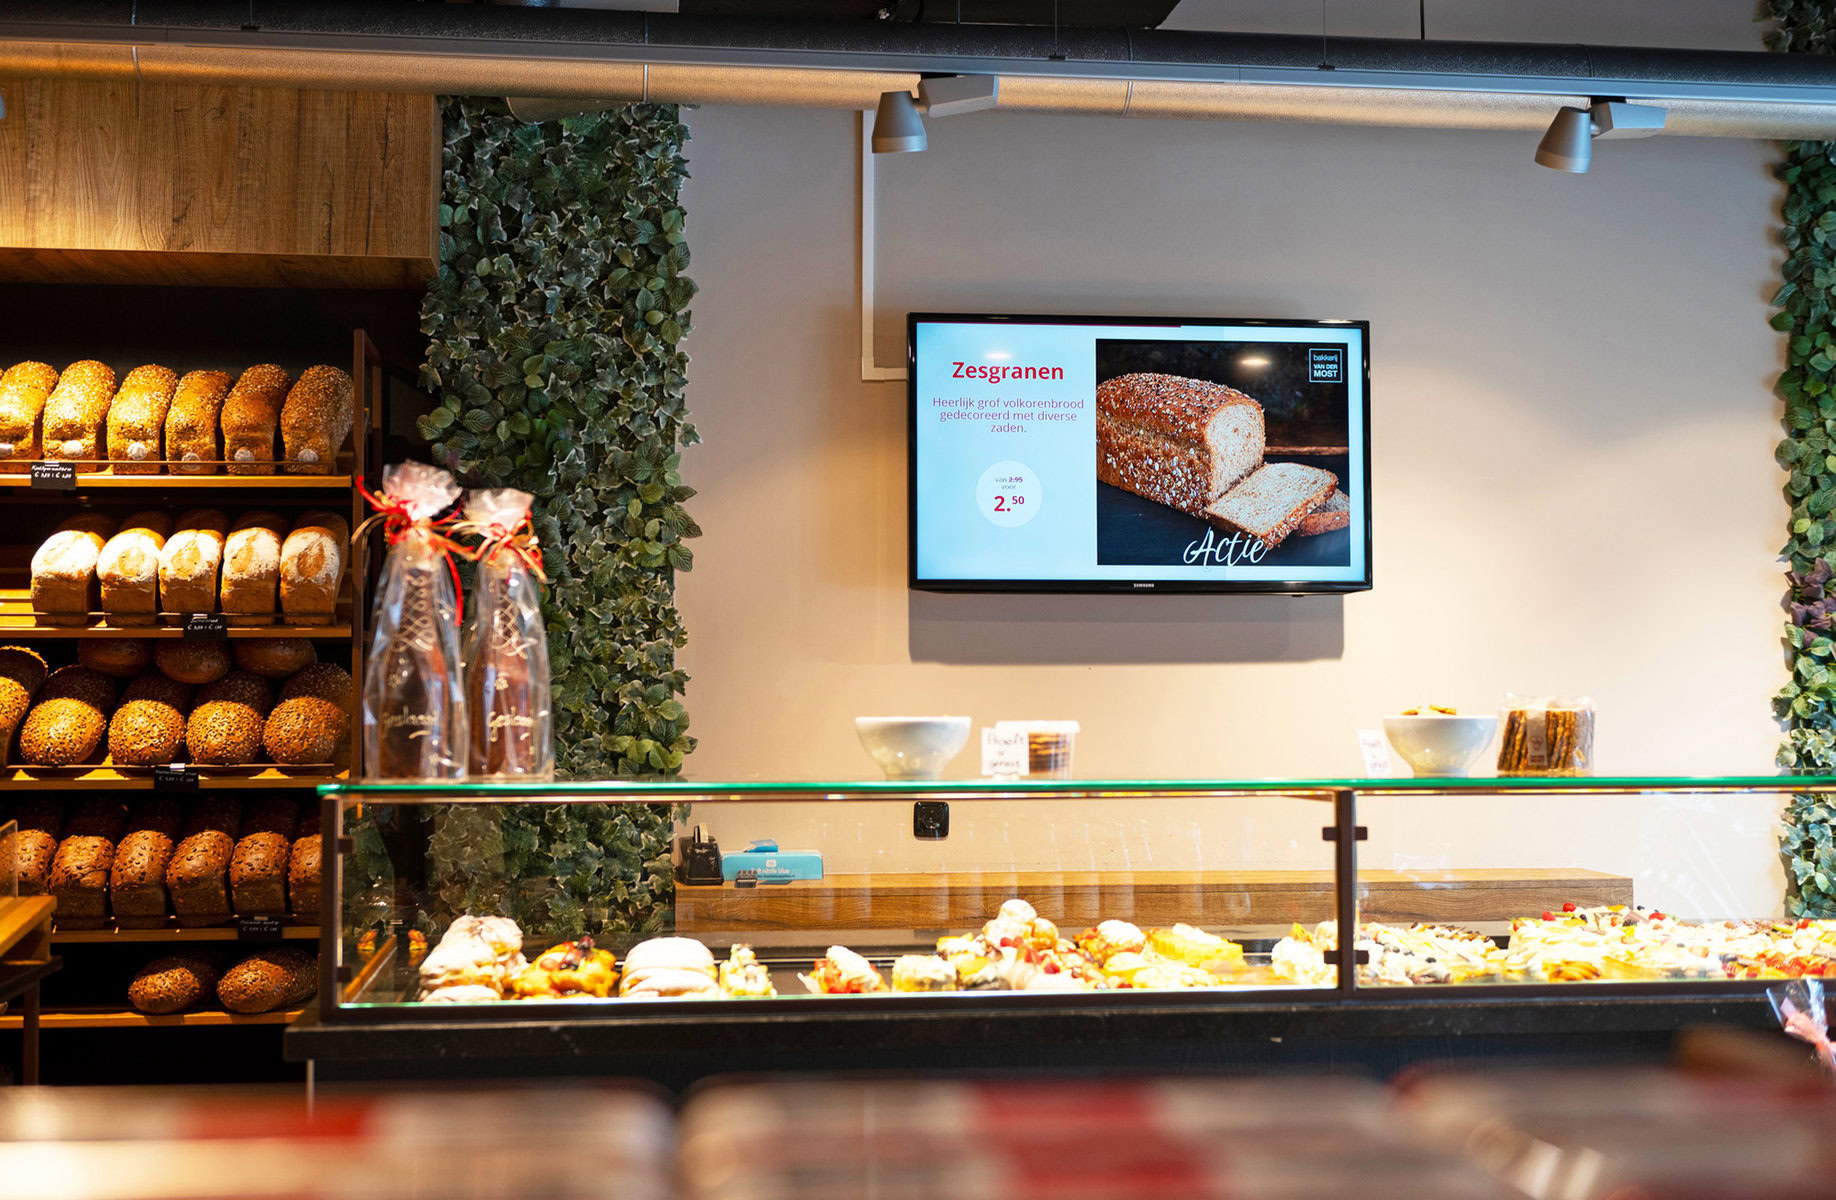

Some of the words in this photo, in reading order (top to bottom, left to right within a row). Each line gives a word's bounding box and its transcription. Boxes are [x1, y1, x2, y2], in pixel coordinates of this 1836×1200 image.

[952, 361, 1064, 384] Zesgranen
[933, 397, 975, 410] Heerlijk
[978, 397, 1001, 410] grof
[1003, 398, 1085, 409] volkorenbrood
[939, 410, 1010, 422] gedecoreerd
[1013, 411, 1034, 421] met
[1037, 411, 1077, 421] diverse
[990, 423, 1027, 433] zaden.
[1183, 526, 1268, 568] Actie
